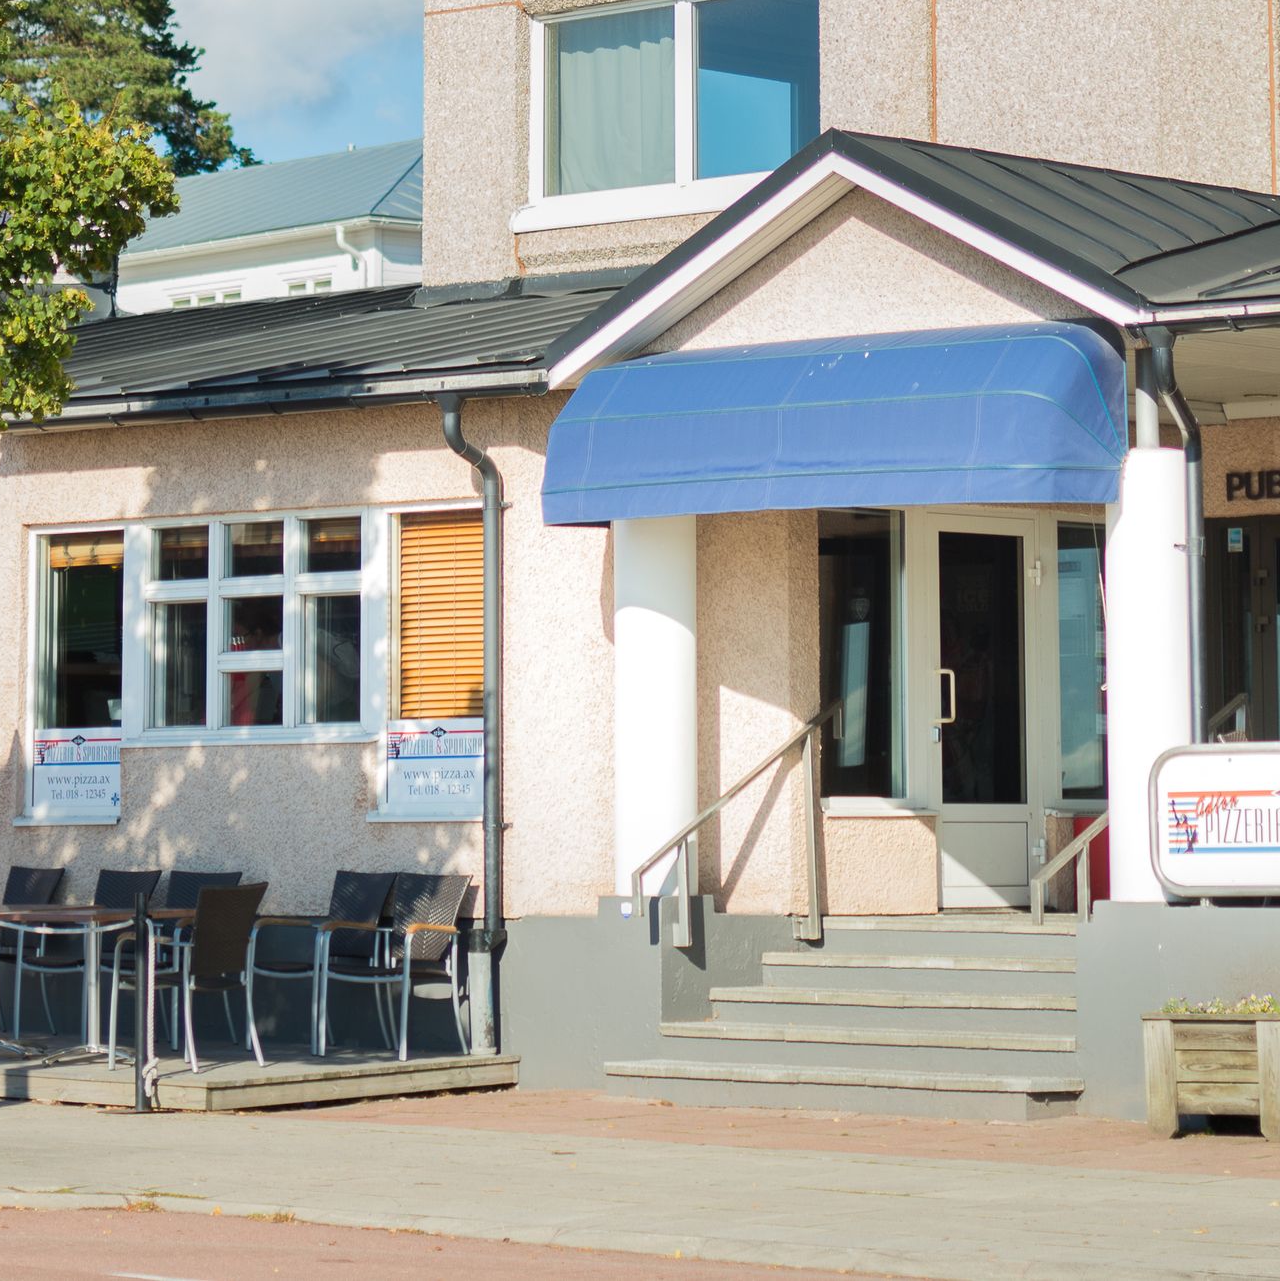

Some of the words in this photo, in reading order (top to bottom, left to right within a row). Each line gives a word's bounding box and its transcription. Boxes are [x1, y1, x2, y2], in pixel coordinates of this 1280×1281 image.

[47, 774, 111, 788] www.pizza.ax
[403, 767, 475, 783] www.pizza.ax
[51, 790, 65, 800] Tel.
[66, 789, 79, 799] 018
[85, 789, 106, 799] 12345
[408, 785, 422, 796] Tel.
[424, 785, 440, 795] 018
[448, 784, 471, 795] 12345
